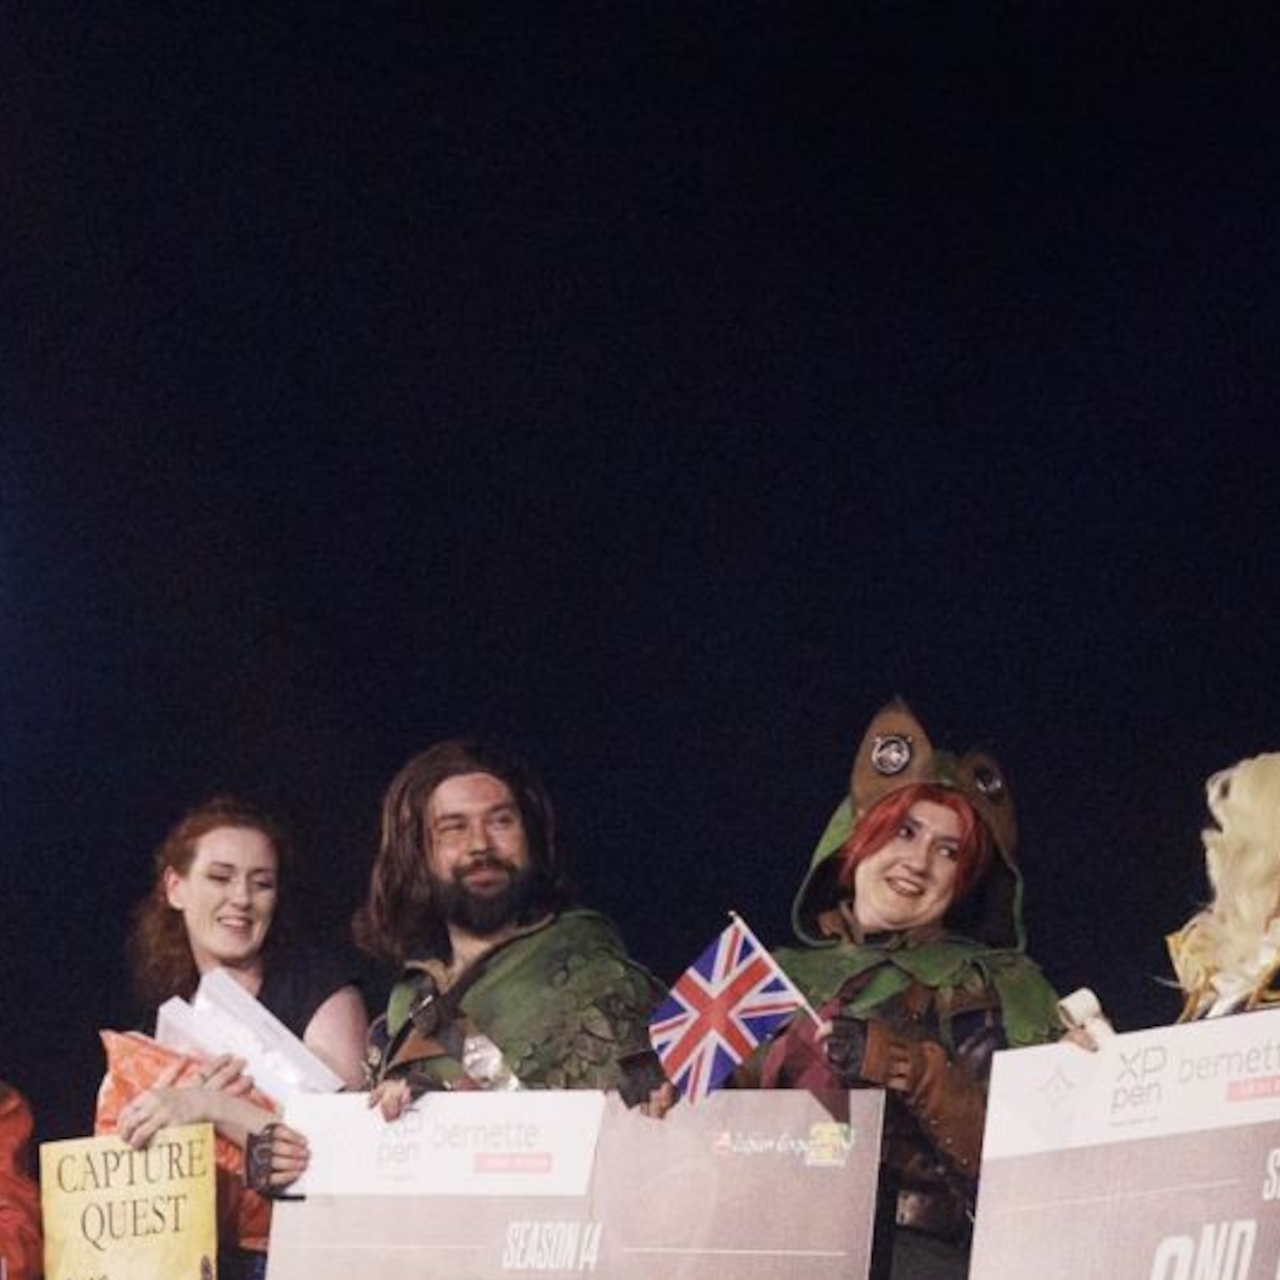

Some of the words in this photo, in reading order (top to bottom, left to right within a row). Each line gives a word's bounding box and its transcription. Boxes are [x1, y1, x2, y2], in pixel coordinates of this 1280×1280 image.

[1117, 1043, 1168, 1083] XP
[1110, 1081, 1162, 1114] pen
[432, 1113, 540, 1149] bernette
[56, 1138, 207, 1194] CAPTURE
[80, 1194, 188, 1251] QUEST
[502, 1221, 573, 1270] SEASON
[575, 1221, 603, 1270] 14
